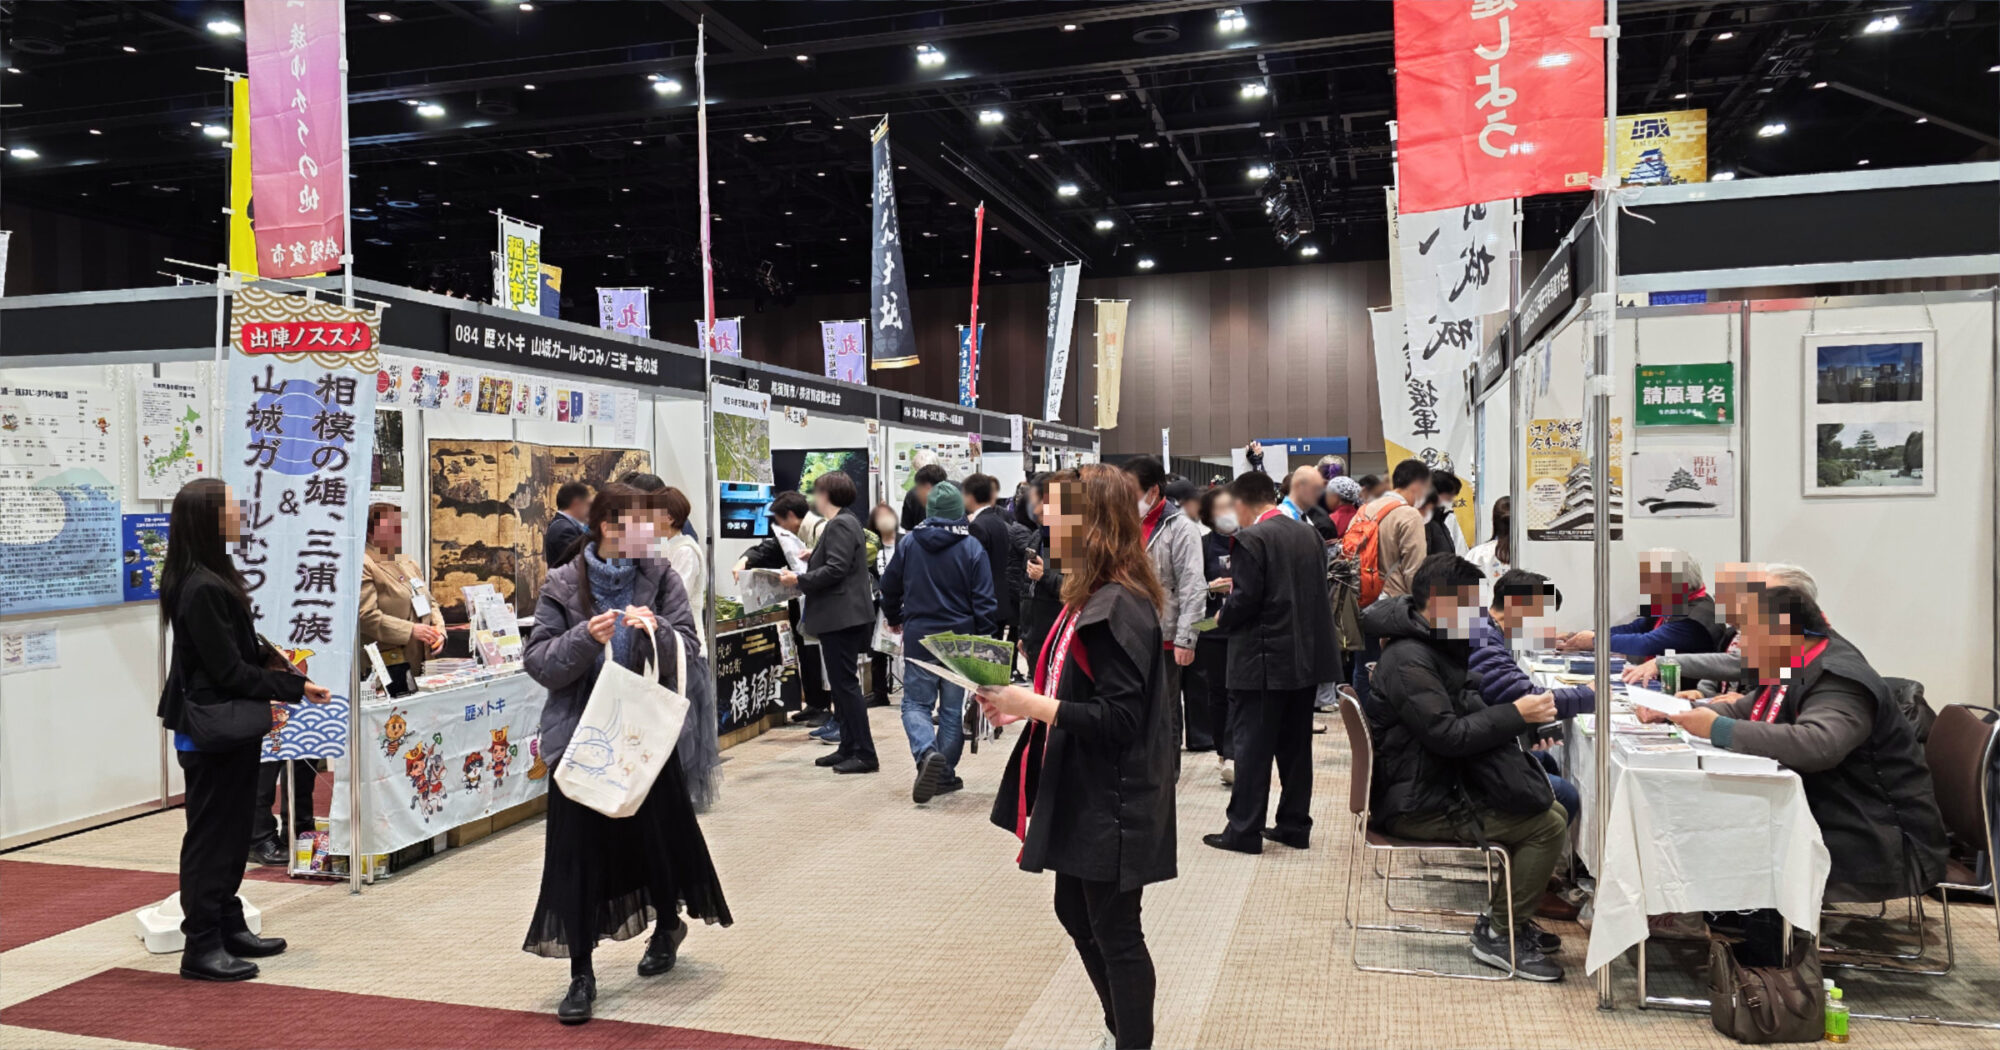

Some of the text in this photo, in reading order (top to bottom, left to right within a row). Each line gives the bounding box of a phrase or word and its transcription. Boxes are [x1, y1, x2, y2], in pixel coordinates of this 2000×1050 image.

[526, 240, 539, 307] ようこそ
[248, 327, 364, 350] 出陣ノススメ
[455, 324, 479, 345] 084
[748, 377, 760, 392] 085
[1643, 385, 1726, 405] 請願署名
[1693, 456, 1705, 477] 再建
[1706, 456, 1719, 486] 江戸城
[279, 489, 300, 516] &
[288, 373, 356, 645] 相模の雄、三浦一族
[730, 664, 785, 724] 横須賀
